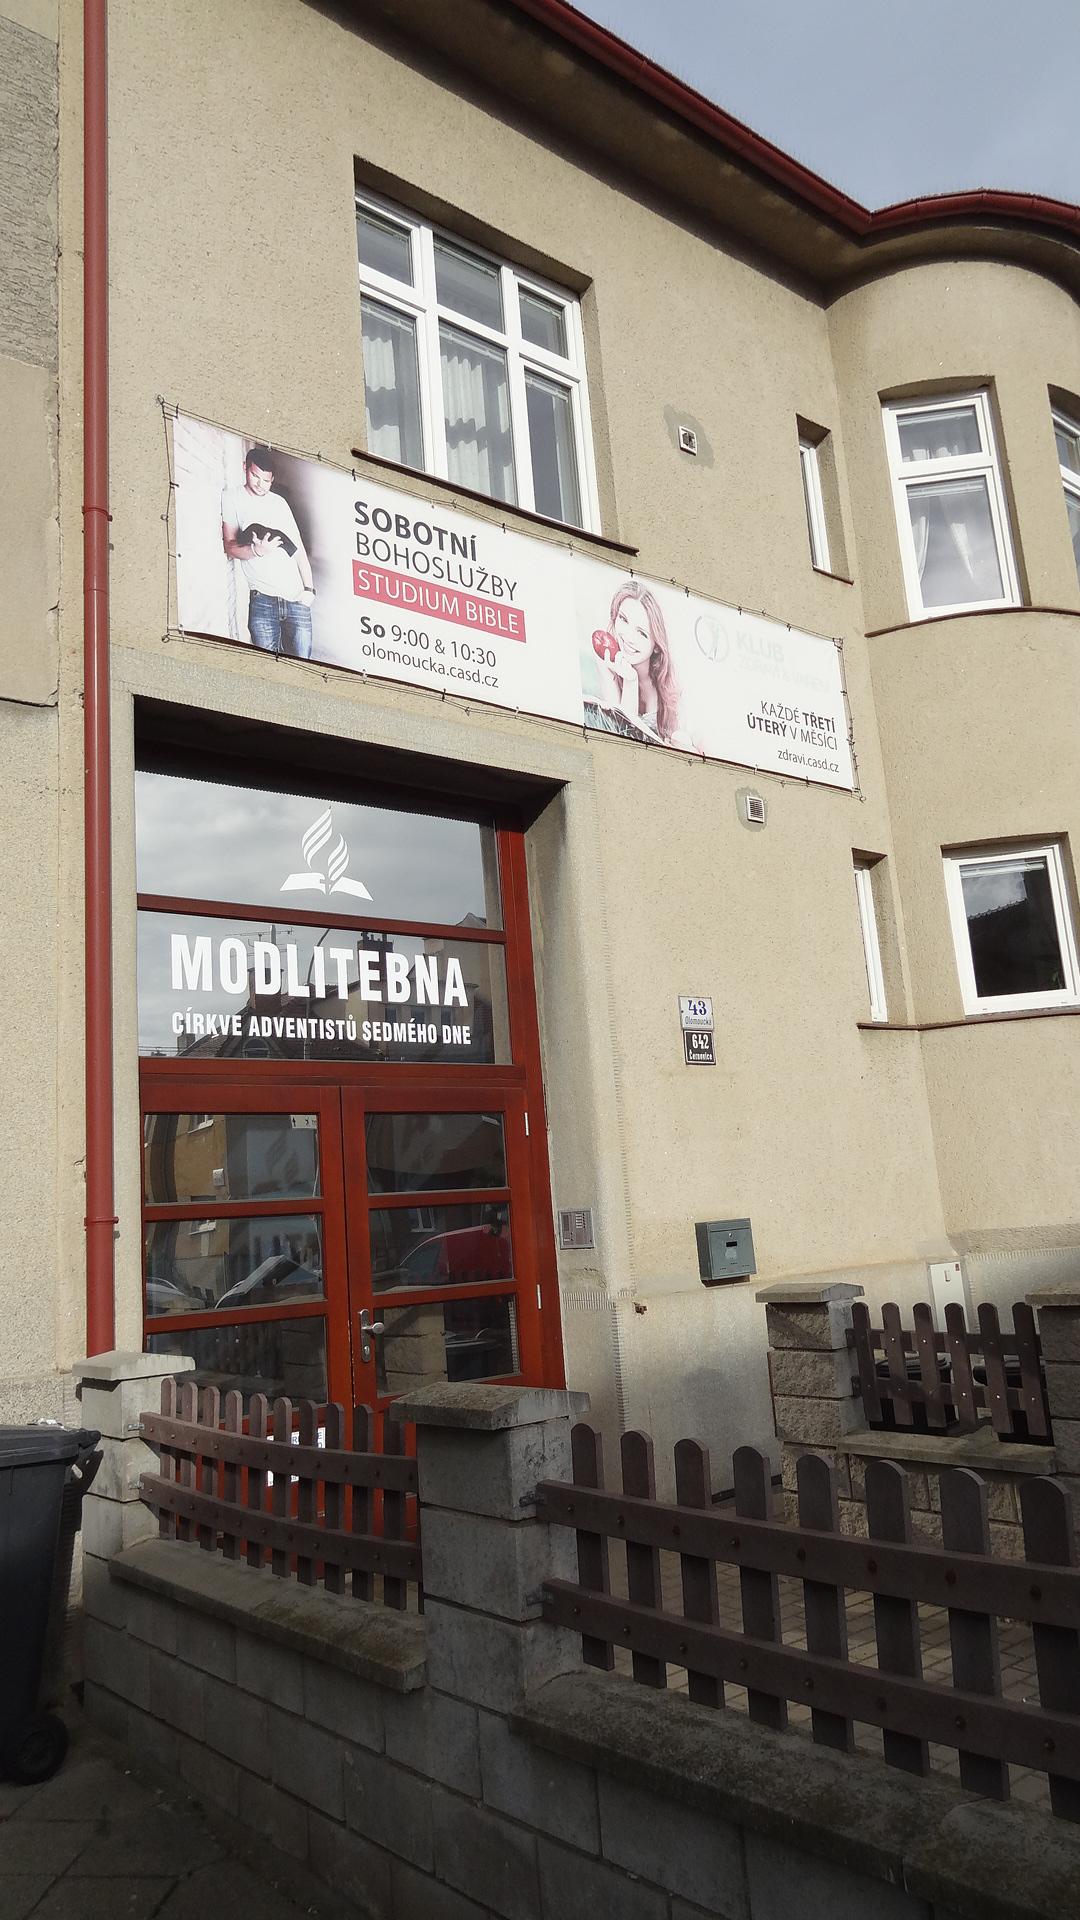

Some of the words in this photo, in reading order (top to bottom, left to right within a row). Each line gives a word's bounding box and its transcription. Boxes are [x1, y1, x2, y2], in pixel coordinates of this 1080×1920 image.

[354, 500, 477, 561] SOBOTNÍ
[355, 532, 518, 601] BOHOSLUŽBY
[358, 569, 460, 617] STUDIUM
[466, 604, 519, 635] BIBLE
[360, 616, 385, 638] So
[391, 625, 429, 650] 9:00
[435, 639, 446, 654] &
[451, 641, 497, 667] 10:30
[362, 642, 499, 689] olomoucka.casd.cz
[747, 713, 787, 737] ÚTERÝ
[789, 726, 798, 739] V
[800, 728, 838, 751] MĚSÍCI
[761, 700, 800, 724] KAŽDÉ
[802, 710, 836, 734] TŘETÍ
[777, 748, 839, 773] zdravi.casd.cz
[170, 933, 468, 1007] MODLITEBNA
[172, 1006, 242, 1040] CÍRKVE
[248, 1013, 357, 1041] ADVENTISTŮ
[362, 1017, 438, 1045] SEDMÉHO
[442, 1024, 472, 1045] DNE
[688, 1000, 707, 1015] 43
[692, 1034, 709, 1049] 642
